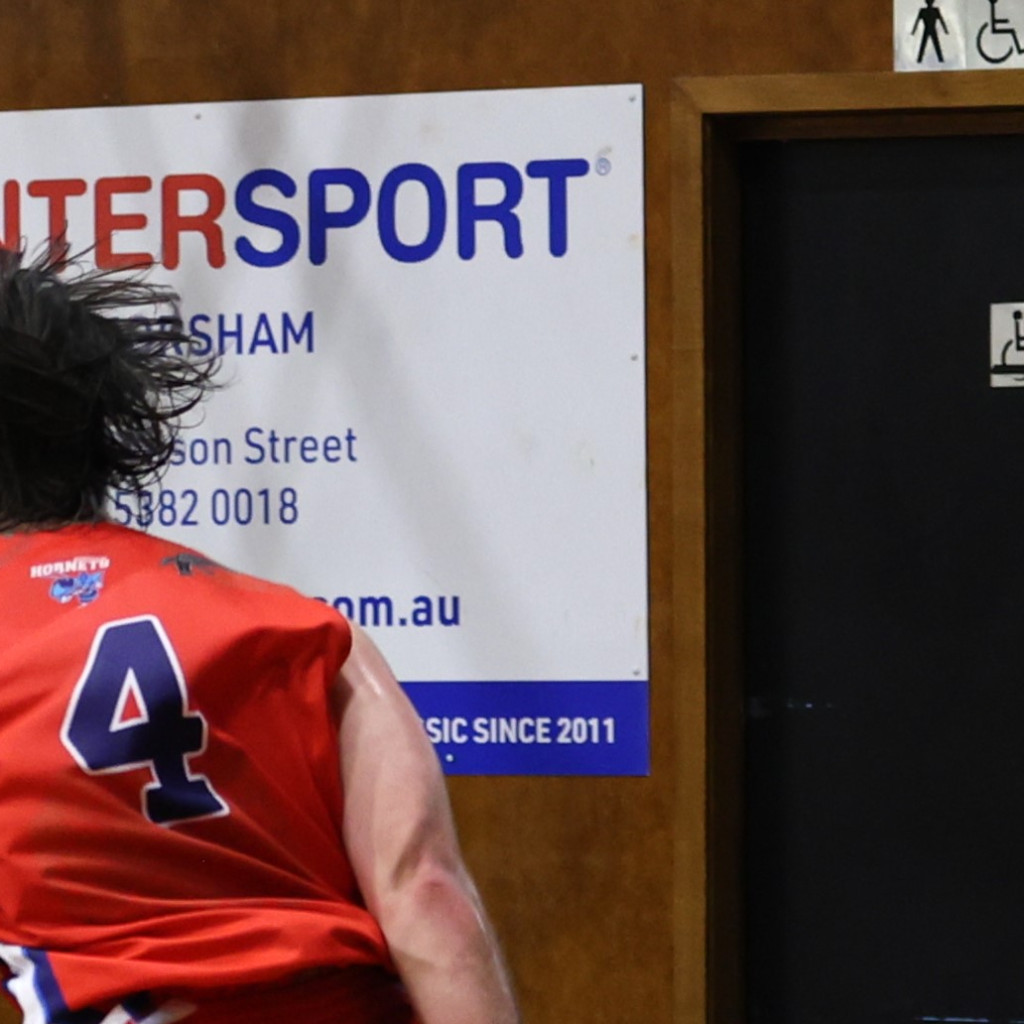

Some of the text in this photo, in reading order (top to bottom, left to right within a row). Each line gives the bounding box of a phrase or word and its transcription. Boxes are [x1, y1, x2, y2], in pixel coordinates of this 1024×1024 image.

[244, 427, 358, 465] Street
[114, 487, 299, 527] 5382 0018
[59, 613, 230, 828] 4
[425, 717, 616, 744] SIC SINCE 2011
